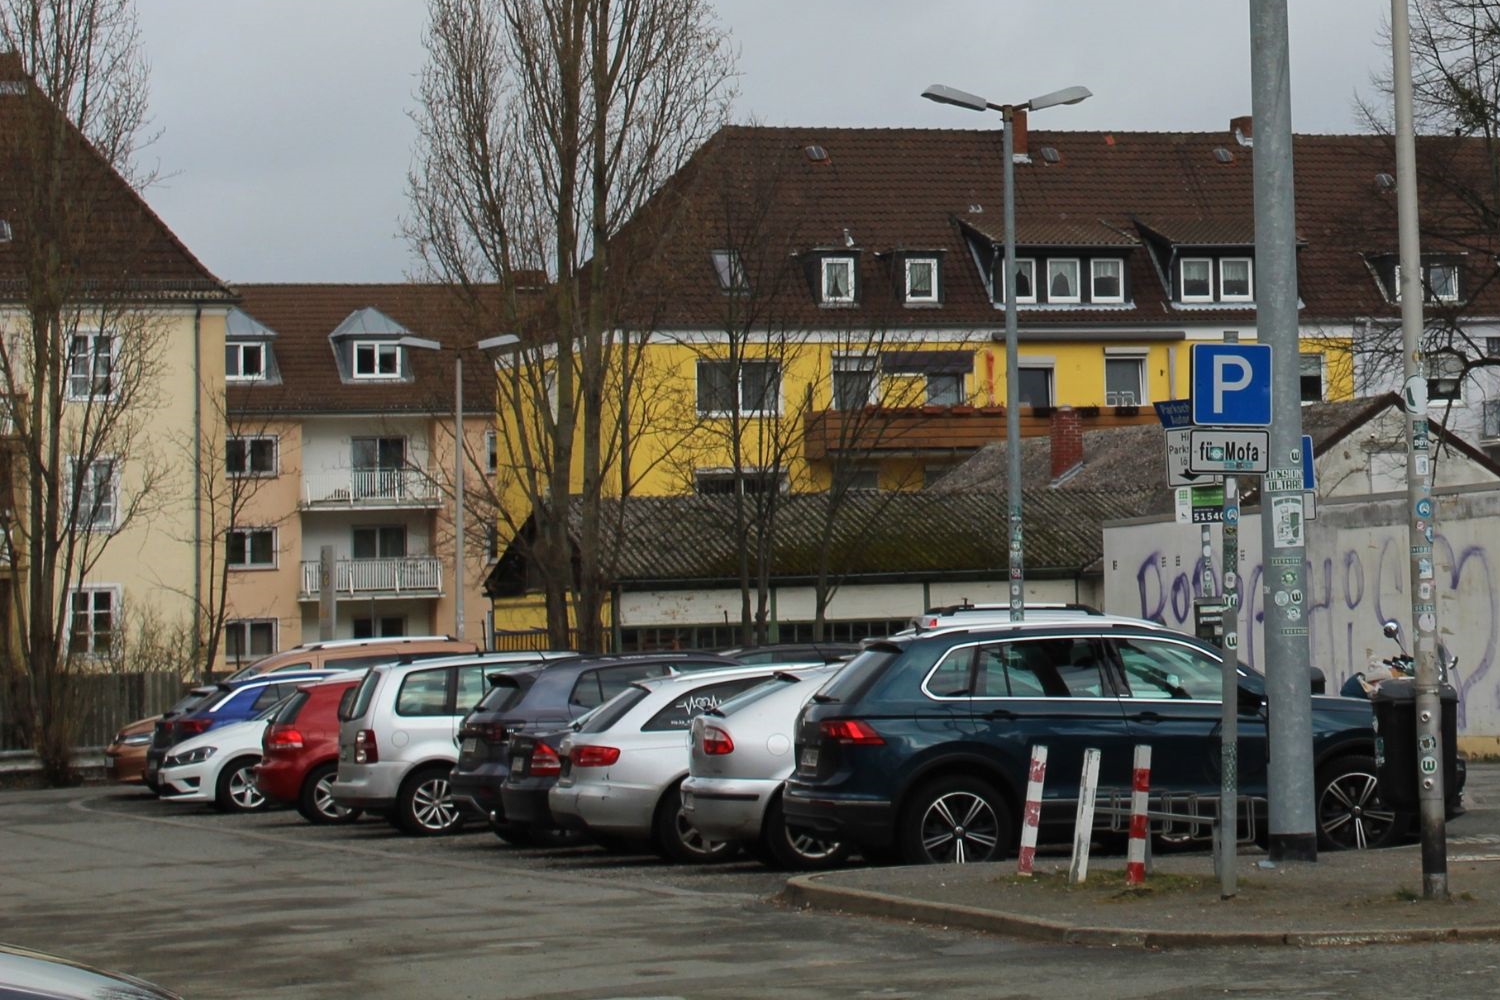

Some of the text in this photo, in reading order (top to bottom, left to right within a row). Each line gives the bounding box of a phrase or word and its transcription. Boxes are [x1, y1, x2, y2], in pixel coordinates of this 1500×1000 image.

[1213, 354, 1253, 414] P
[1181, 432, 1190, 441] Hi
[1169, 444, 1190, 455] Park
[1200, 441, 1259, 462] fü Mofa
